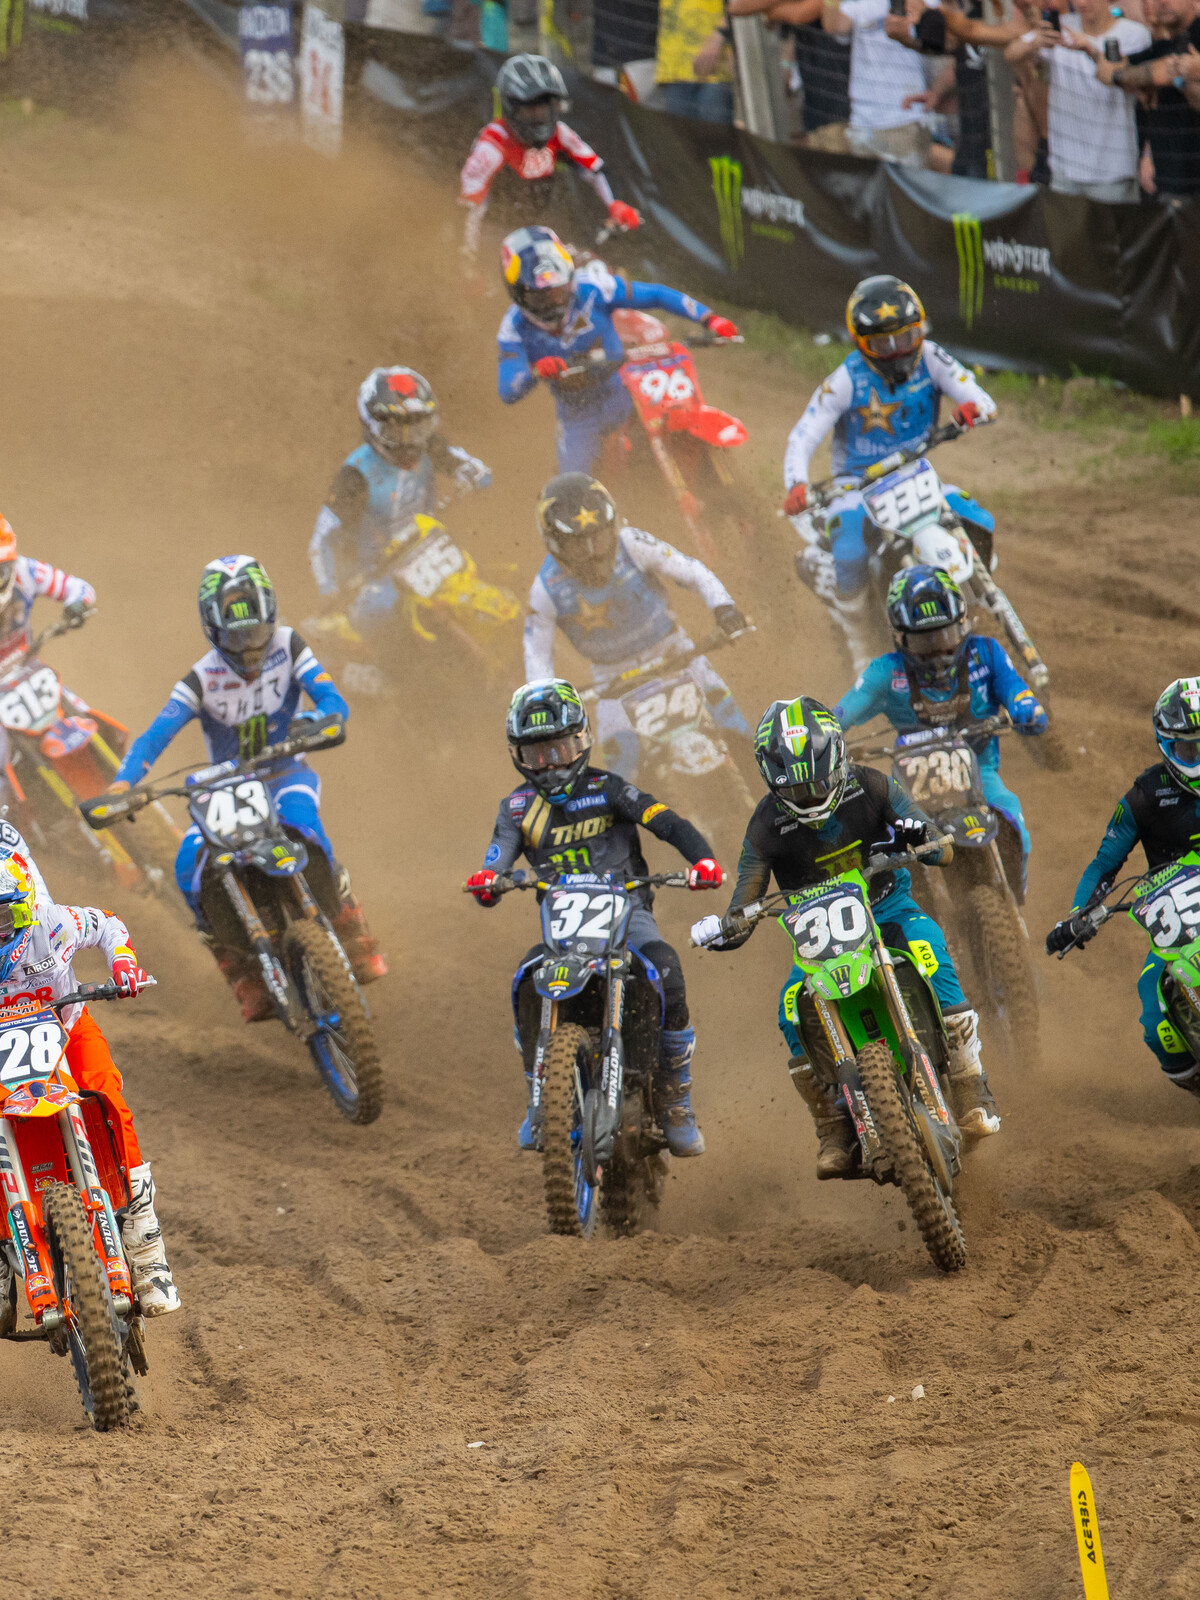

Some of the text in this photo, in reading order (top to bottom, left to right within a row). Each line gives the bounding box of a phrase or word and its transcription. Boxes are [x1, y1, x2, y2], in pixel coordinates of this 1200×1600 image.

[983, 236, 1052, 276] MONSTER
[638, 368, 694, 404] 96
[873, 475, 942, 530] 339
[634, 682, 699, 738] 24
[786, 727, 804, 737] BELL
[205, 780, 270, 837] 43
[551, 815, 613, 846] THOR
[551, 892, 625, 940] 32
[794, 896, 868, 959] 30
[1145, 875, 1200, 948] 35
[27, 956, 55, 975] AIROH
[918, 944, 934, 968] FOX
[787, 990, 795, 1014] FOX
[818, 999, 845, 1055] PRO CIRCUIT
[1160, 1025, 1176, 1050] FOX
[608, 1046, 620, 1110] DUNLOP
[1077, 1490, 1097, 1564] ACERBIS
